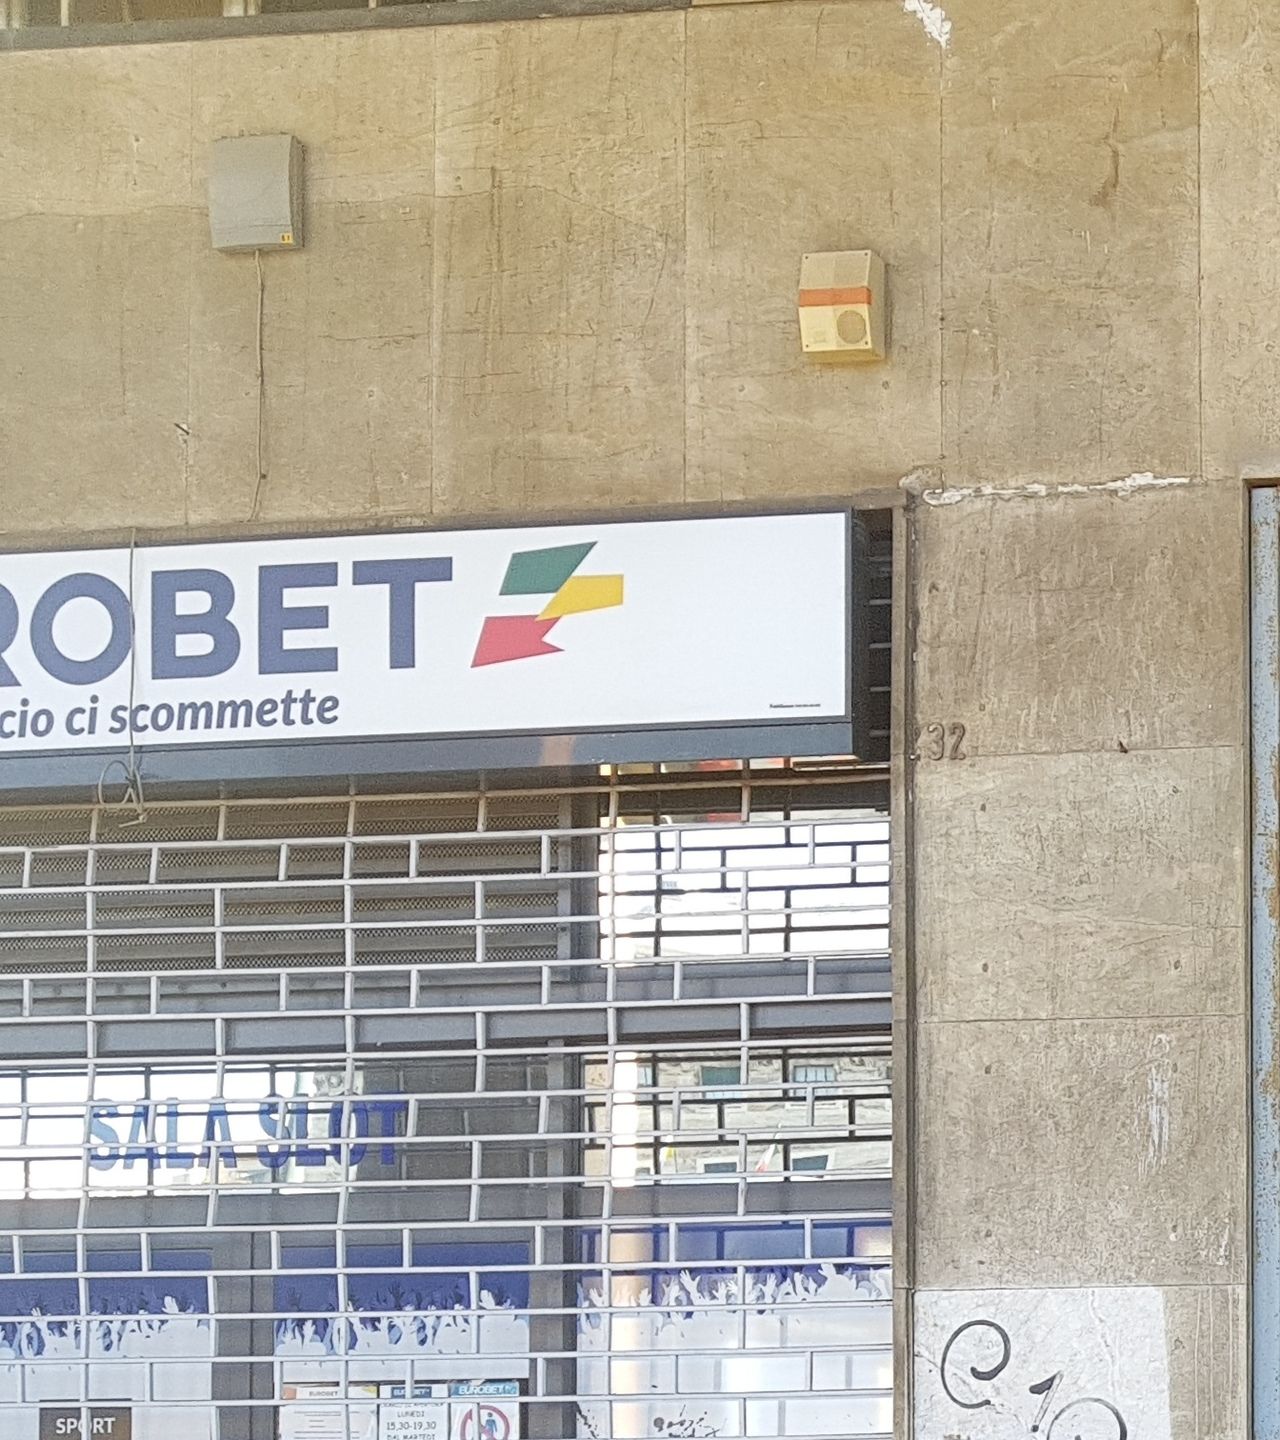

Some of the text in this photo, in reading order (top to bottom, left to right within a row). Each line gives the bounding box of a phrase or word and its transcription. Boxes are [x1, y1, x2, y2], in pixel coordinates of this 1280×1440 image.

[0, 557, 453, 687] OBET
[65, 694, 99, 736] ci
[109, 689, 340, 732] scommette
[90, 1091, 406, 1171] SALA SLOT
